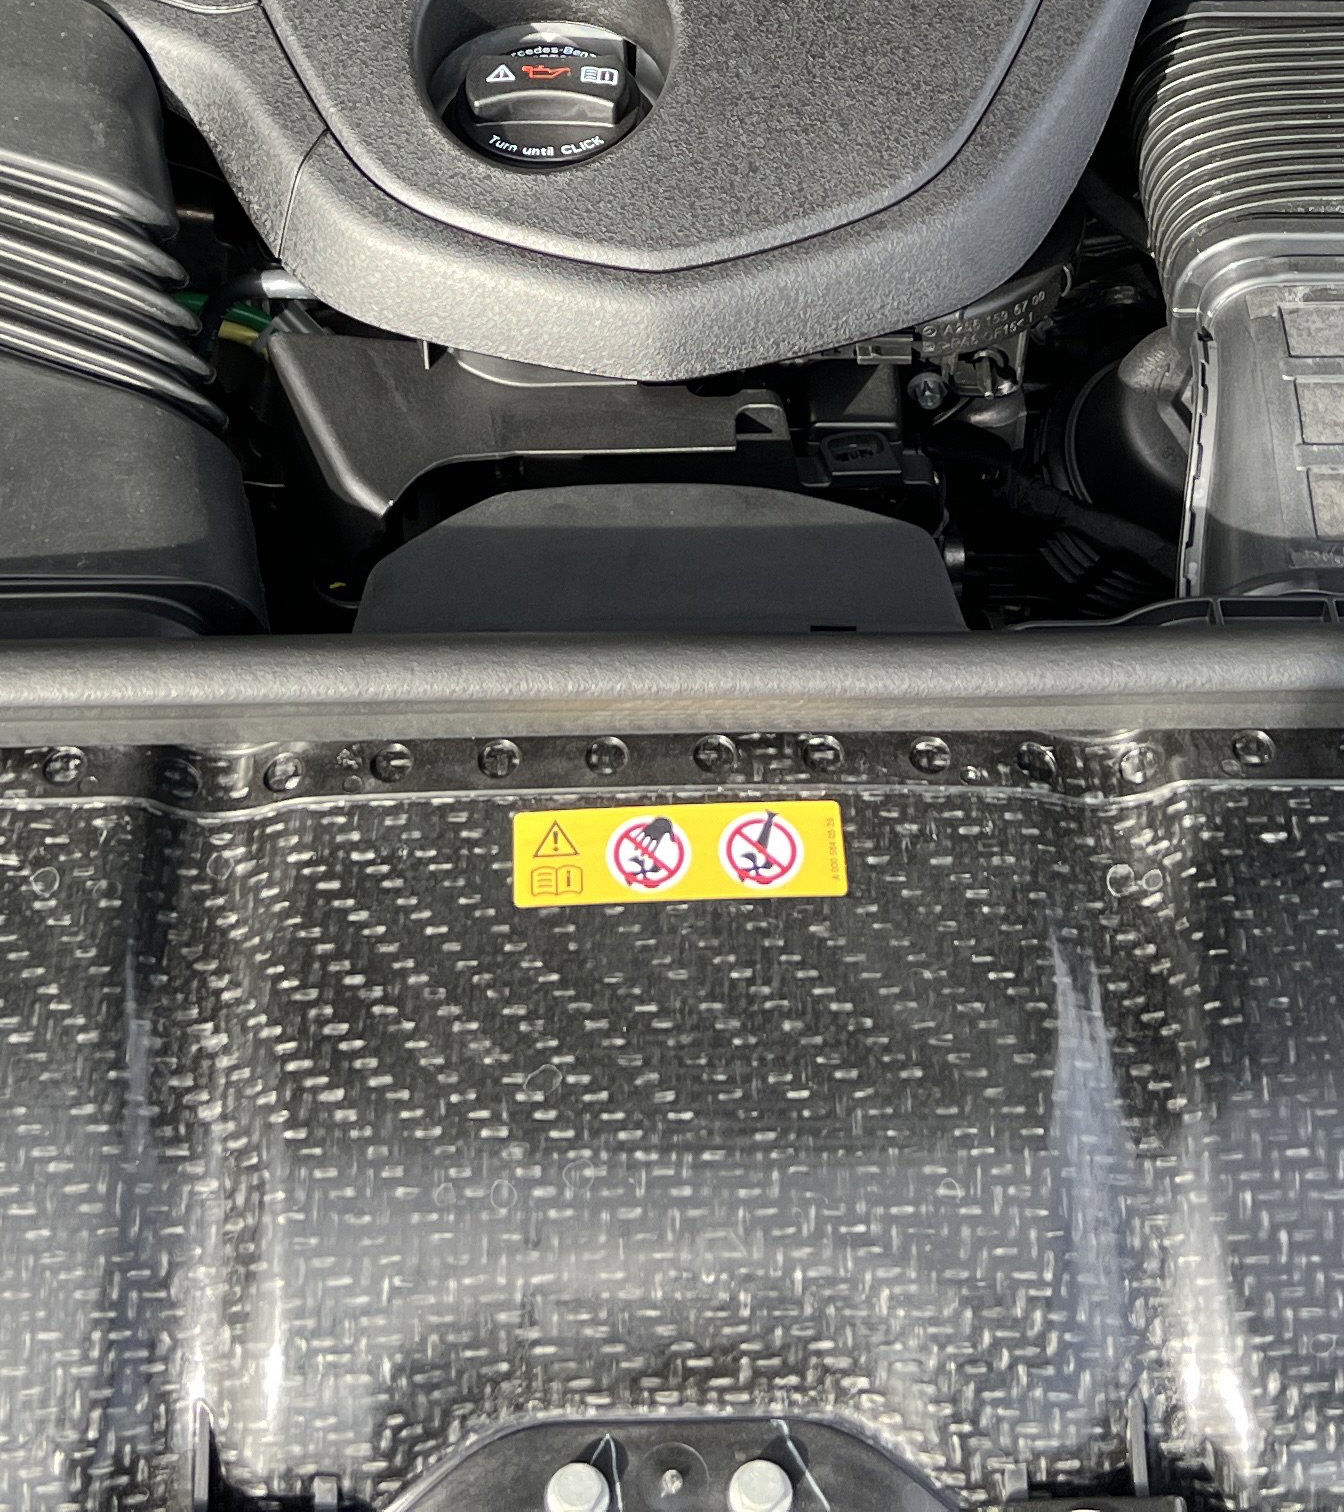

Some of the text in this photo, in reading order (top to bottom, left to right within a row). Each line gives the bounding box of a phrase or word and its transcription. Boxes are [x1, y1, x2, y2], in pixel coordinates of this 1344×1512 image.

[489, 134, 605, 157] Turn until CLICK
